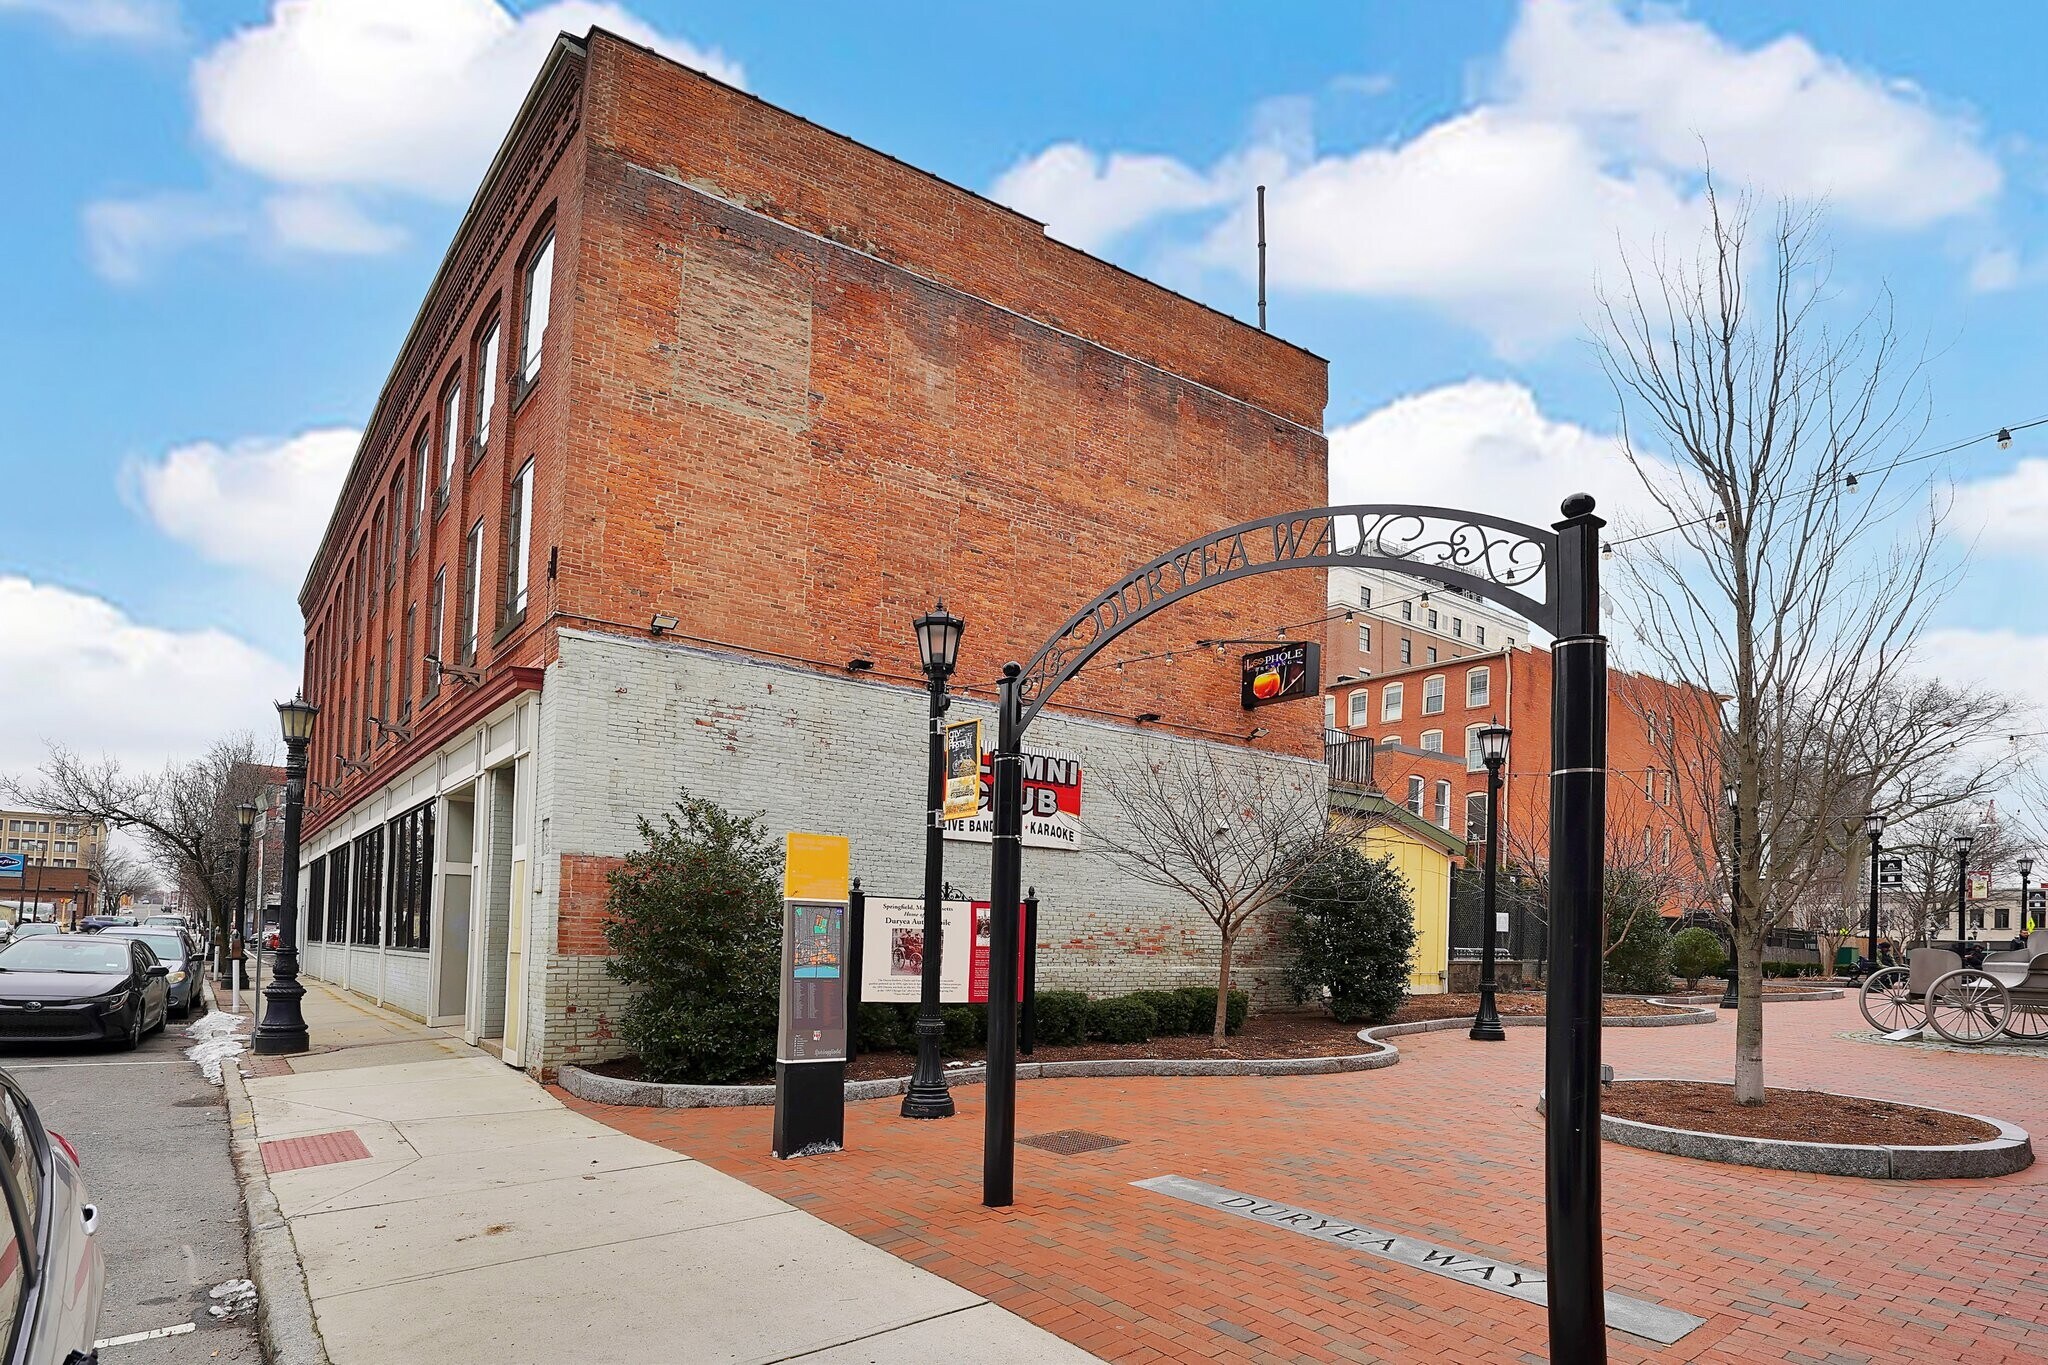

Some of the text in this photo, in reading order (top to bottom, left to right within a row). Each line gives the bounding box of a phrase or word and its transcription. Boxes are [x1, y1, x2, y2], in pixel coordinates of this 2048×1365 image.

[1097, 514, 1382, 633] DURYEA WAY
[978, 781, 1057, 815] CUB
[1030, 821, 1075, 842] KARAOKE
[882, 903, 914, 911] Springfield,
[885, 917, 910, 926] Duryea
[1217, 1195, 1547, 1290] DURYEA WAY
